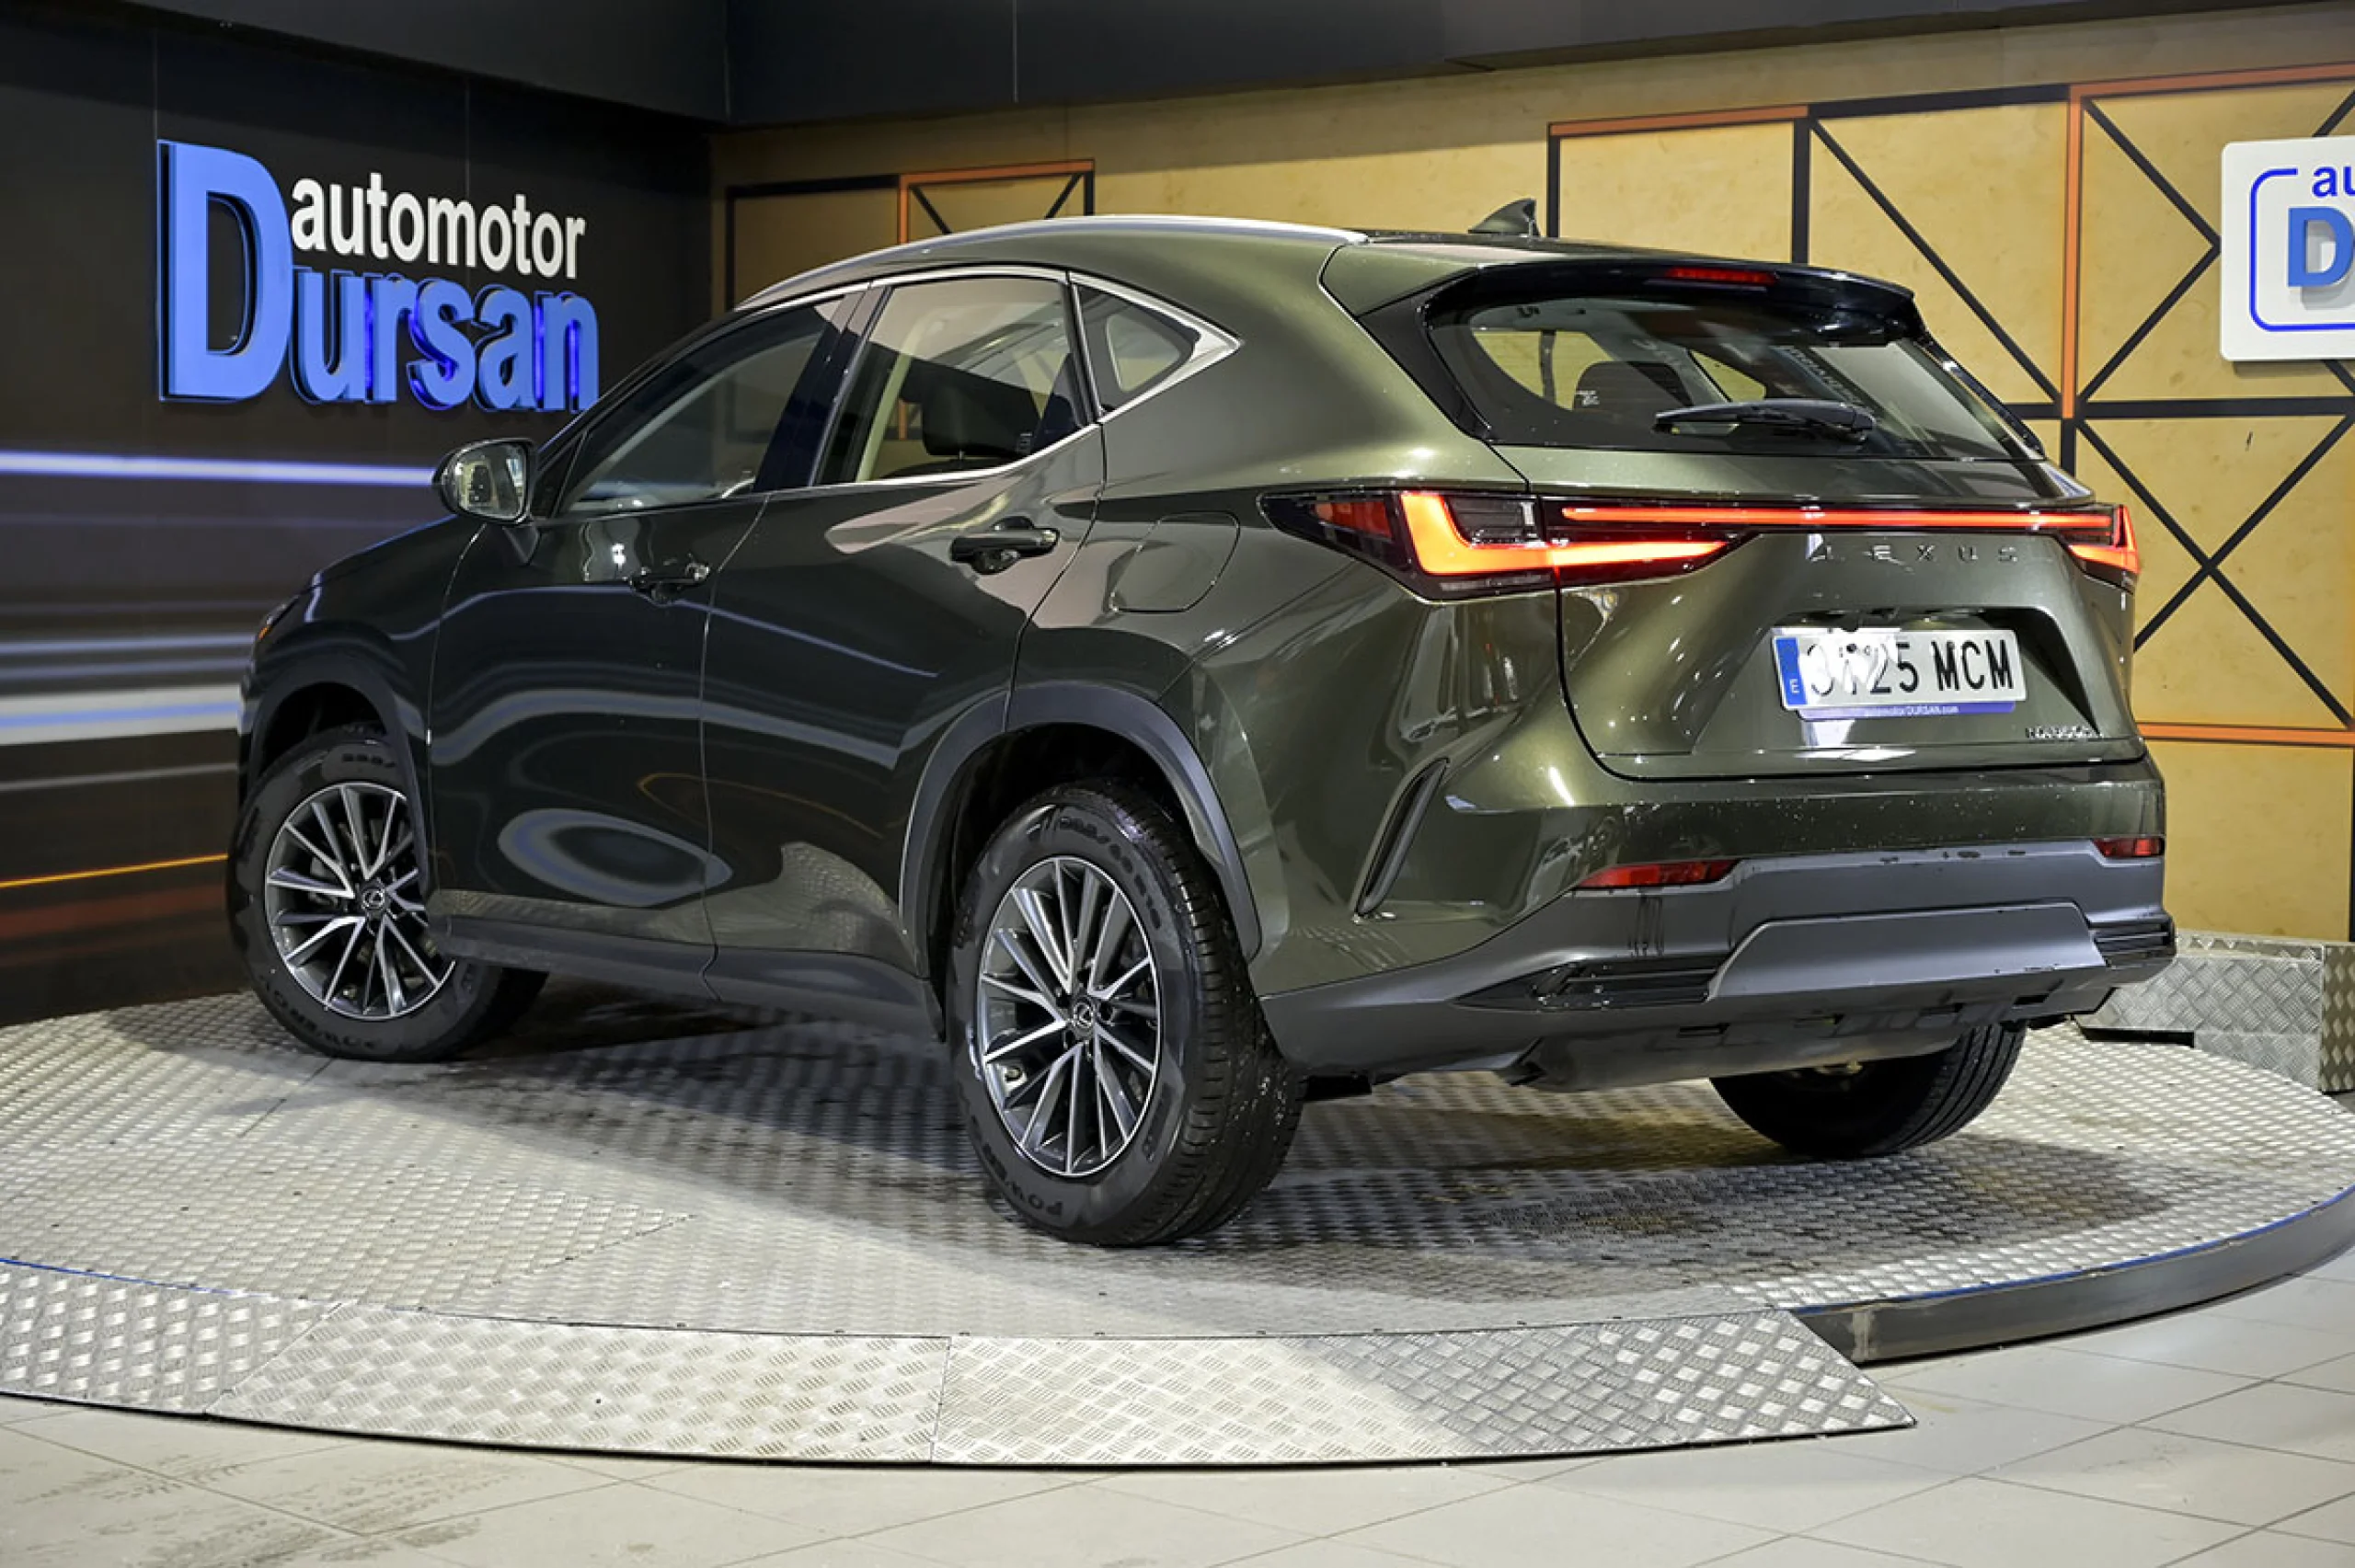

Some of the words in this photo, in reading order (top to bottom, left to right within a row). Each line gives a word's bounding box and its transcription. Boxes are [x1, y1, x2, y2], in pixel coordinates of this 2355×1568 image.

[156, 139, 599, 413] Dursan
[292, 172, 585, 279] automotor
[1931, 638, 2014, 692] MCM
